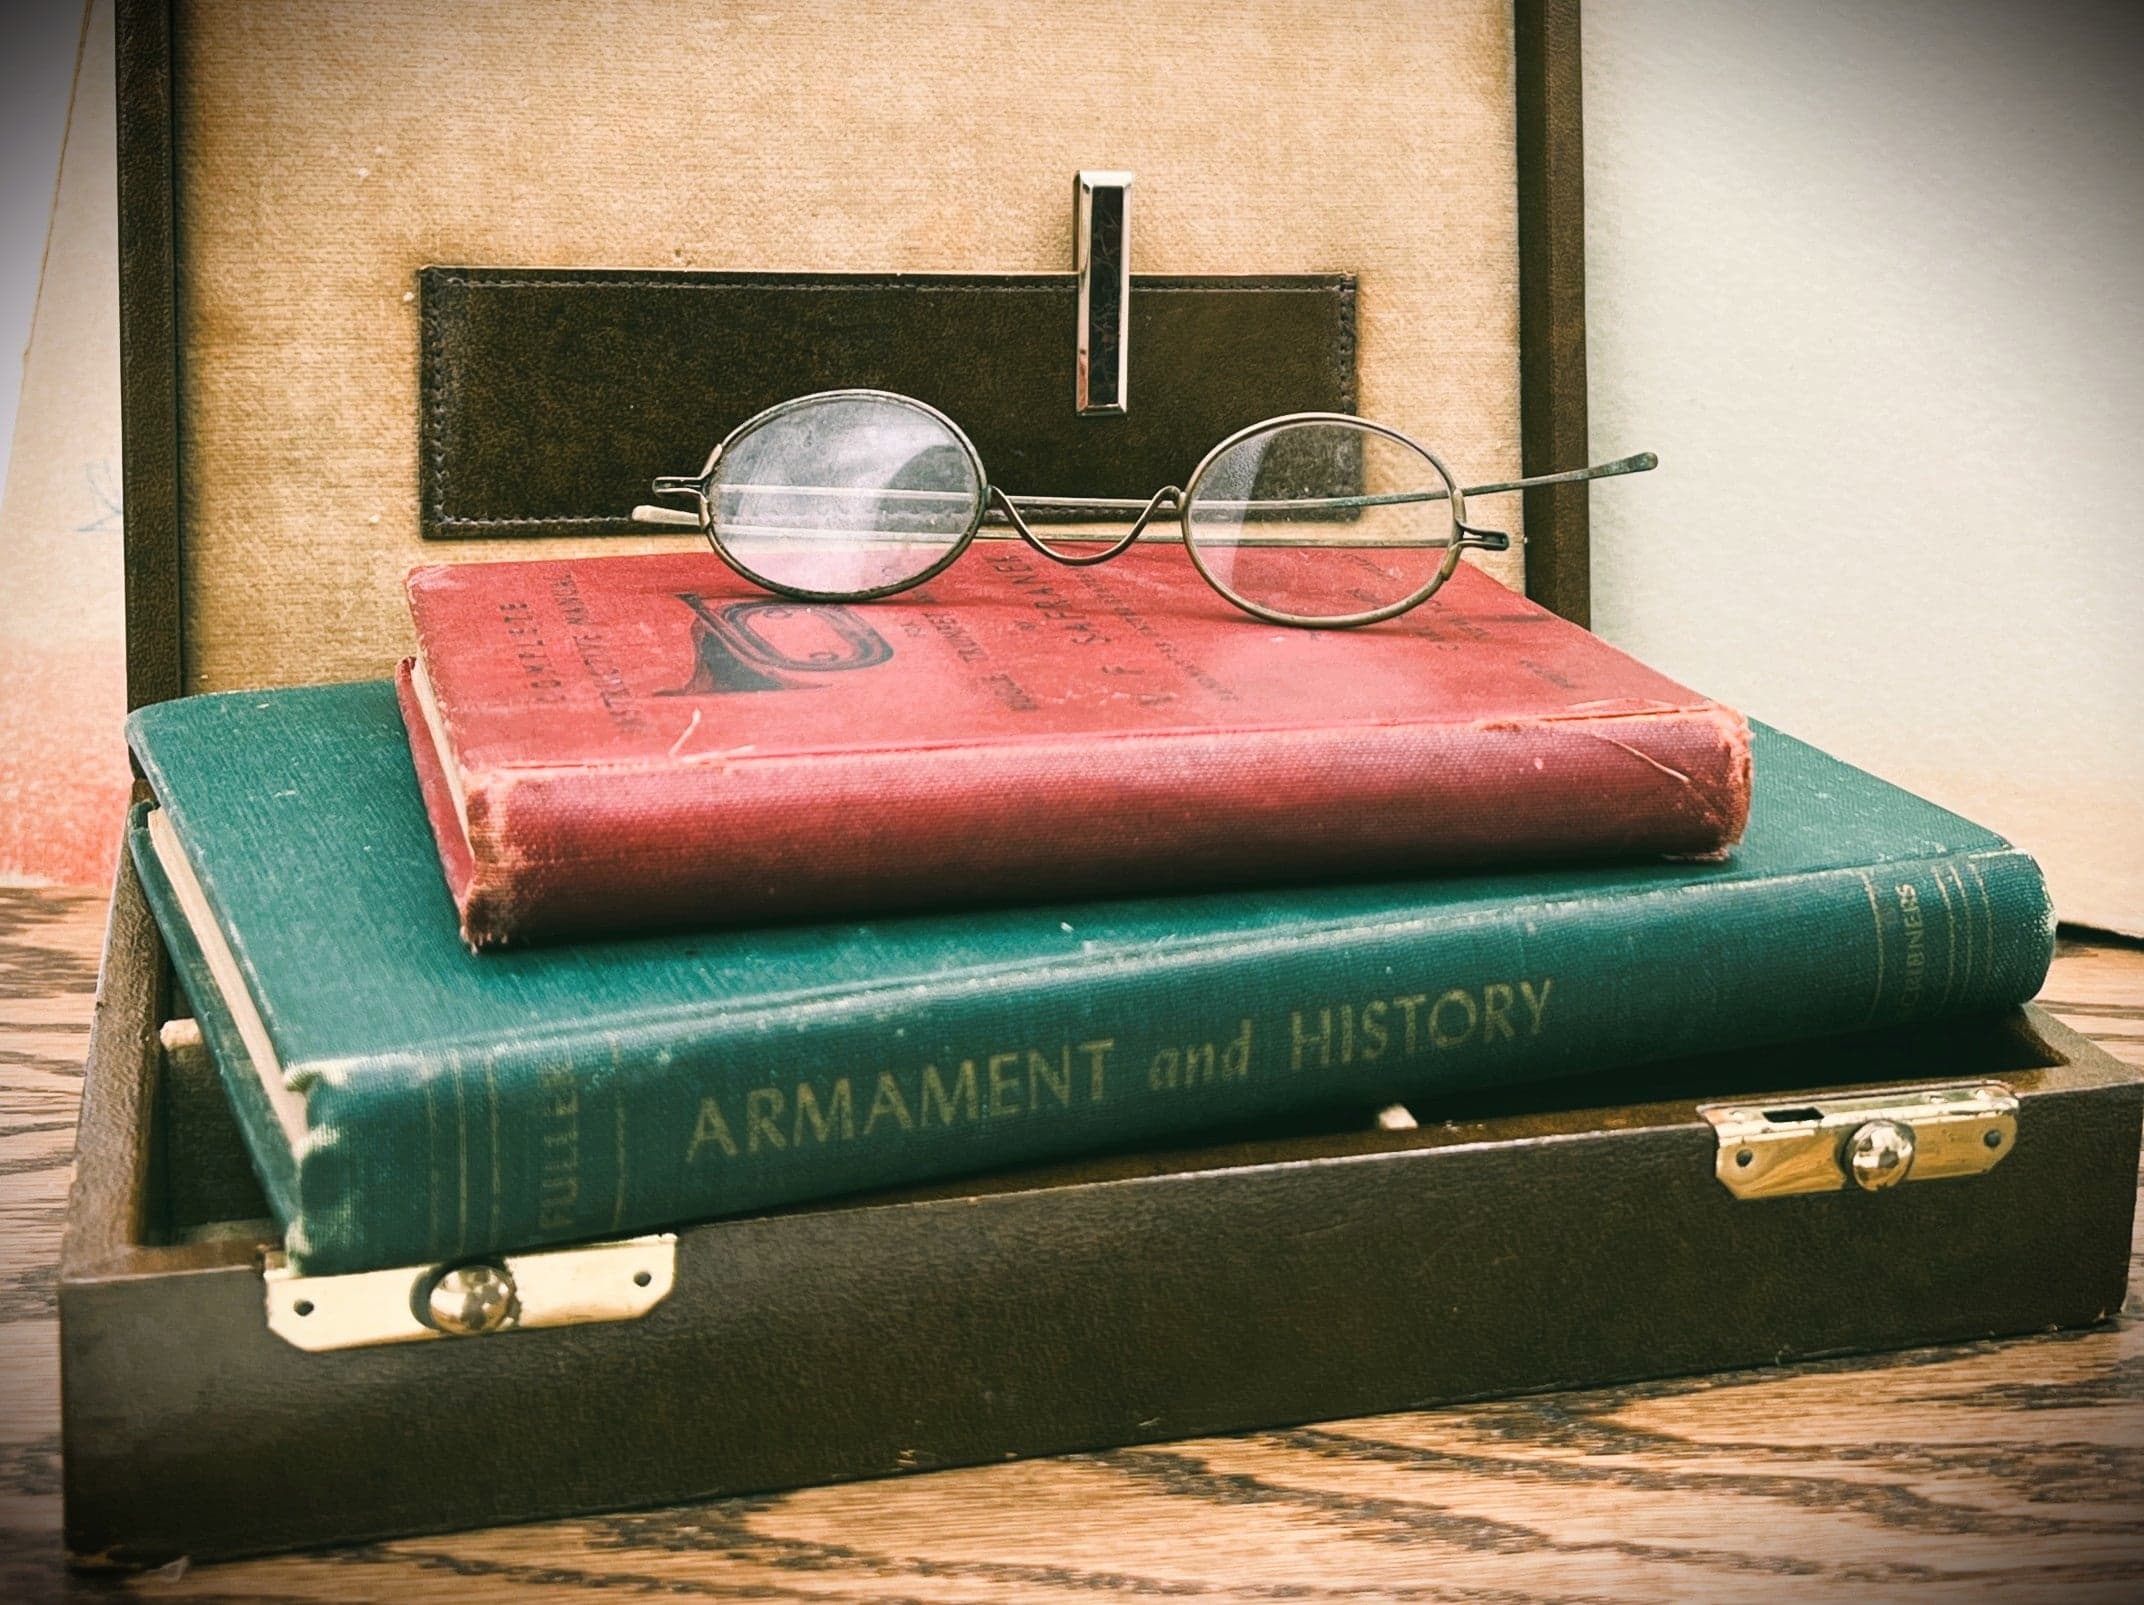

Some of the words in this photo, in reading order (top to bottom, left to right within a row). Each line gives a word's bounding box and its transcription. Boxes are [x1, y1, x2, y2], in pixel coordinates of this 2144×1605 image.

[686, 1040, 1115, 1164] ARMAMENT
[1149, 1021, 1251, 1092] and
[1291, 979, 1555, 1071] HISTORY
